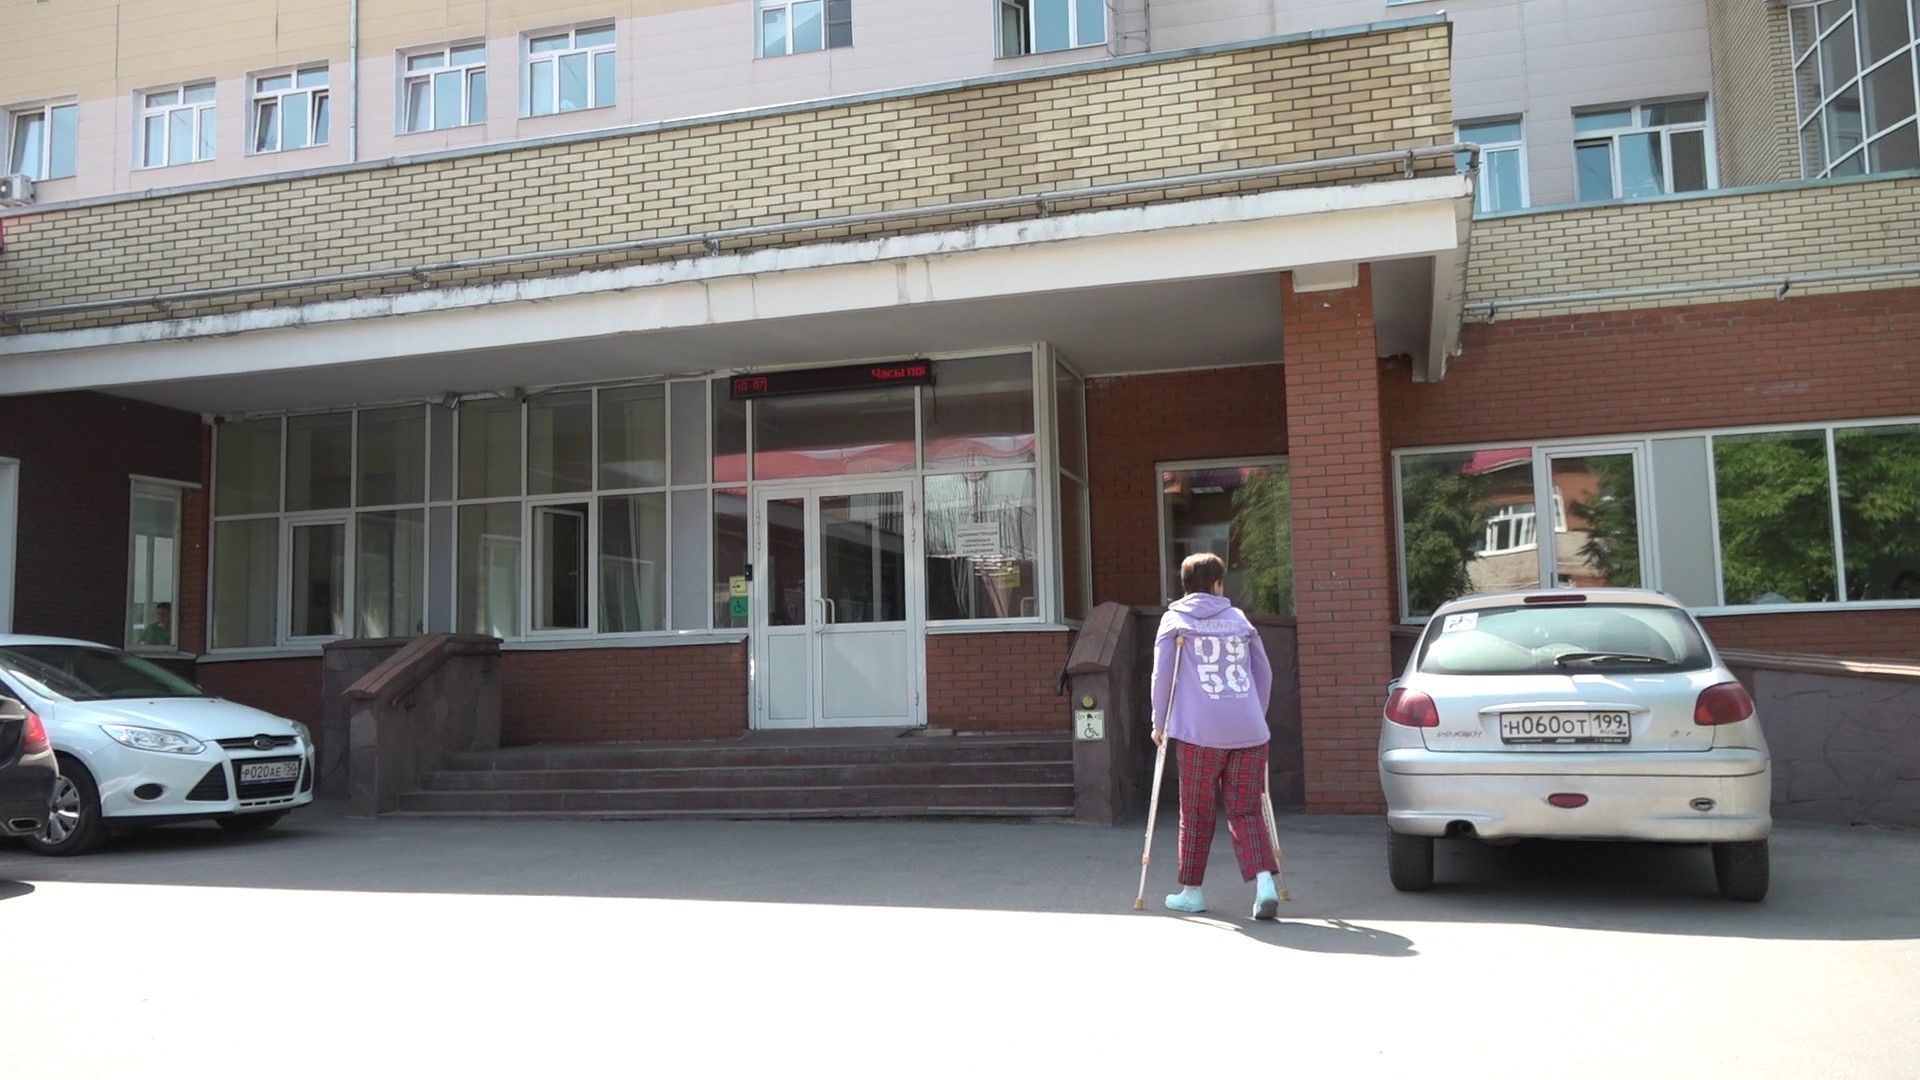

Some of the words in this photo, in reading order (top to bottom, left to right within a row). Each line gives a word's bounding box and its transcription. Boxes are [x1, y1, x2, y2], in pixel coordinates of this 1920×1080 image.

[871, 367, 905, 380] Часы
[1508, 715, 1587, 735] Н060ОТ
[1594, 714, 1623, 729] 199
